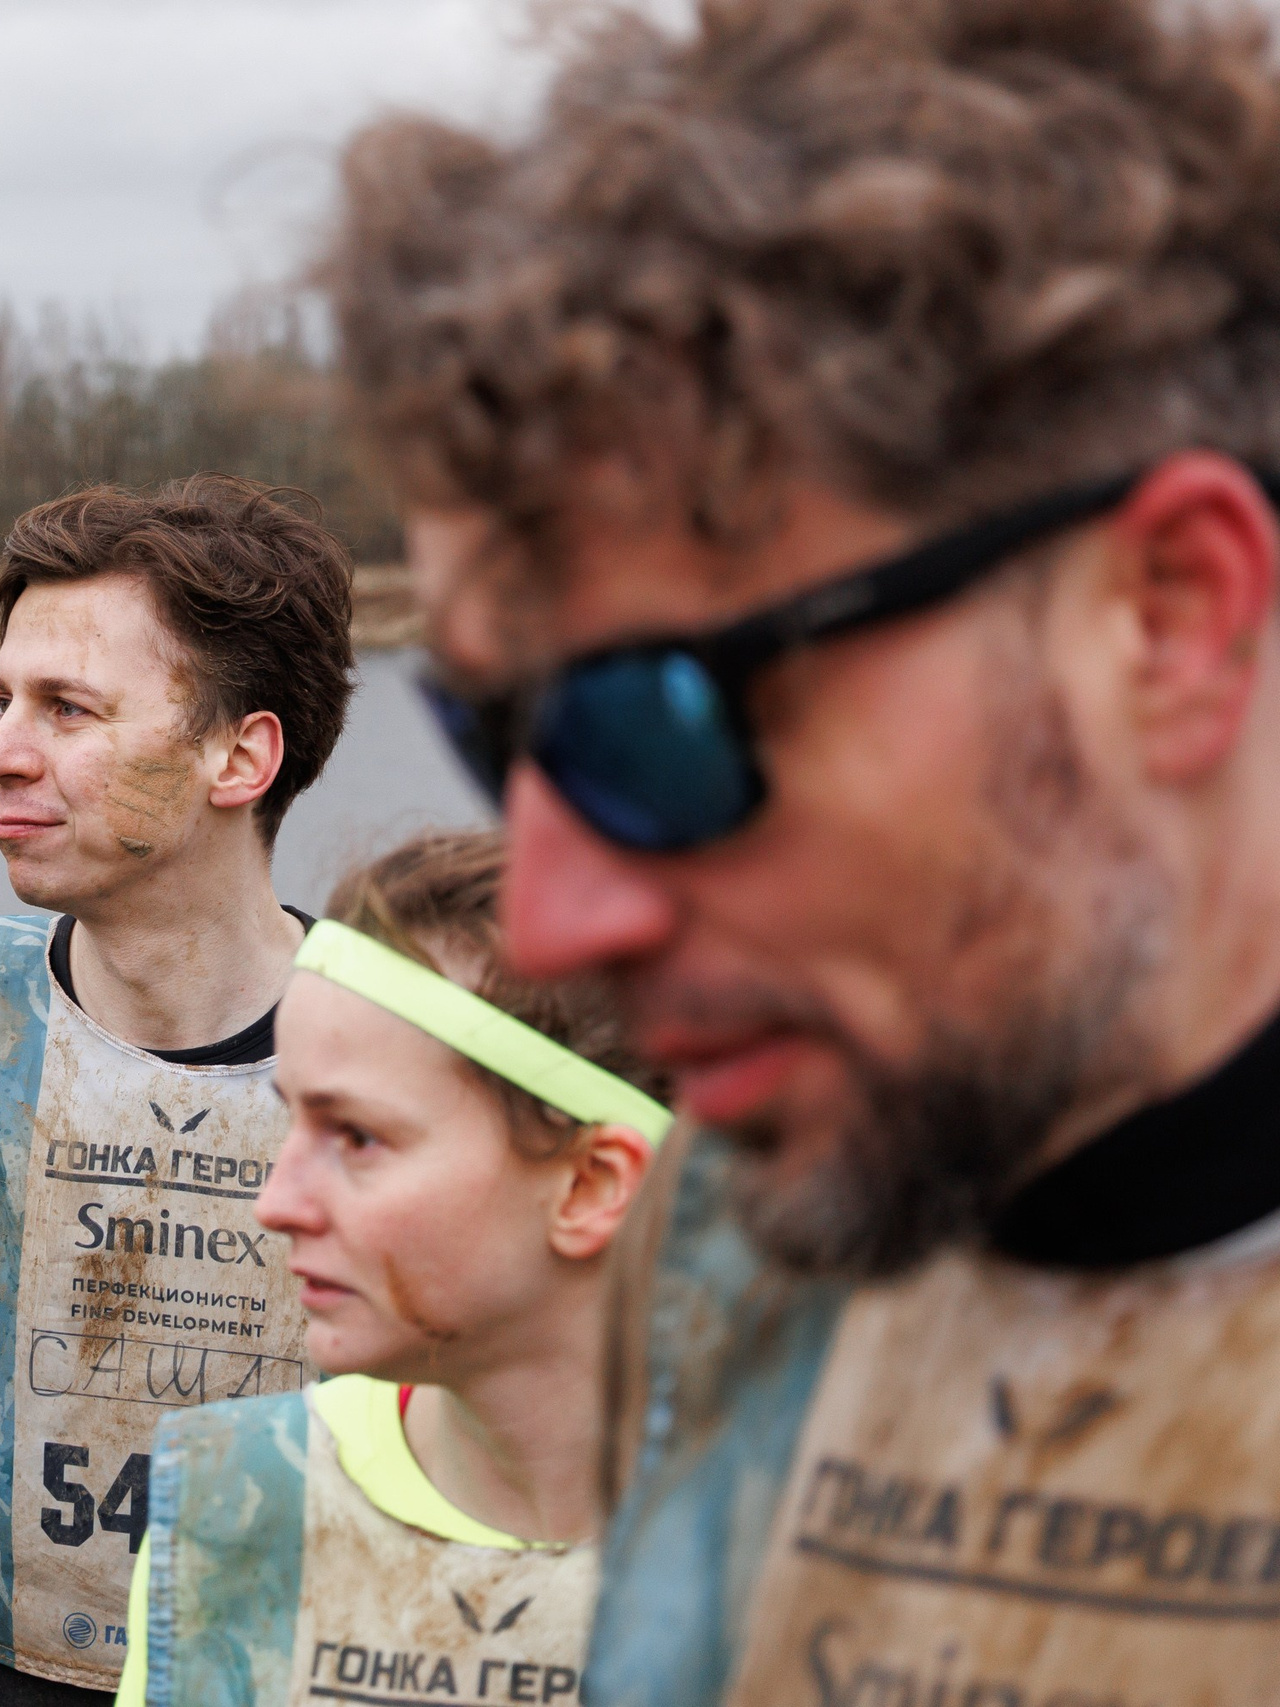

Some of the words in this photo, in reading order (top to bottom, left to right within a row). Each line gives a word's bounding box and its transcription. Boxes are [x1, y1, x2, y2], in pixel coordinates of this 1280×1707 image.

[45, 1139, 158, 1176] ГОНКА
[170, 1149, 274, 1188] ГЕРО
[75, 1202, 267, 1268] Sminex
[70, 1303, 120, 1321] FINE
[122, 1309, 265, 1338] DEVELOPMENT
[71, 1277, 267, 1313] ПЕРФЕКЦИОНИСТЫ
[984, 1492, 1280, 1585] ГЕРОЕ
[311, 1641, 458, 1696] ГОНКА
